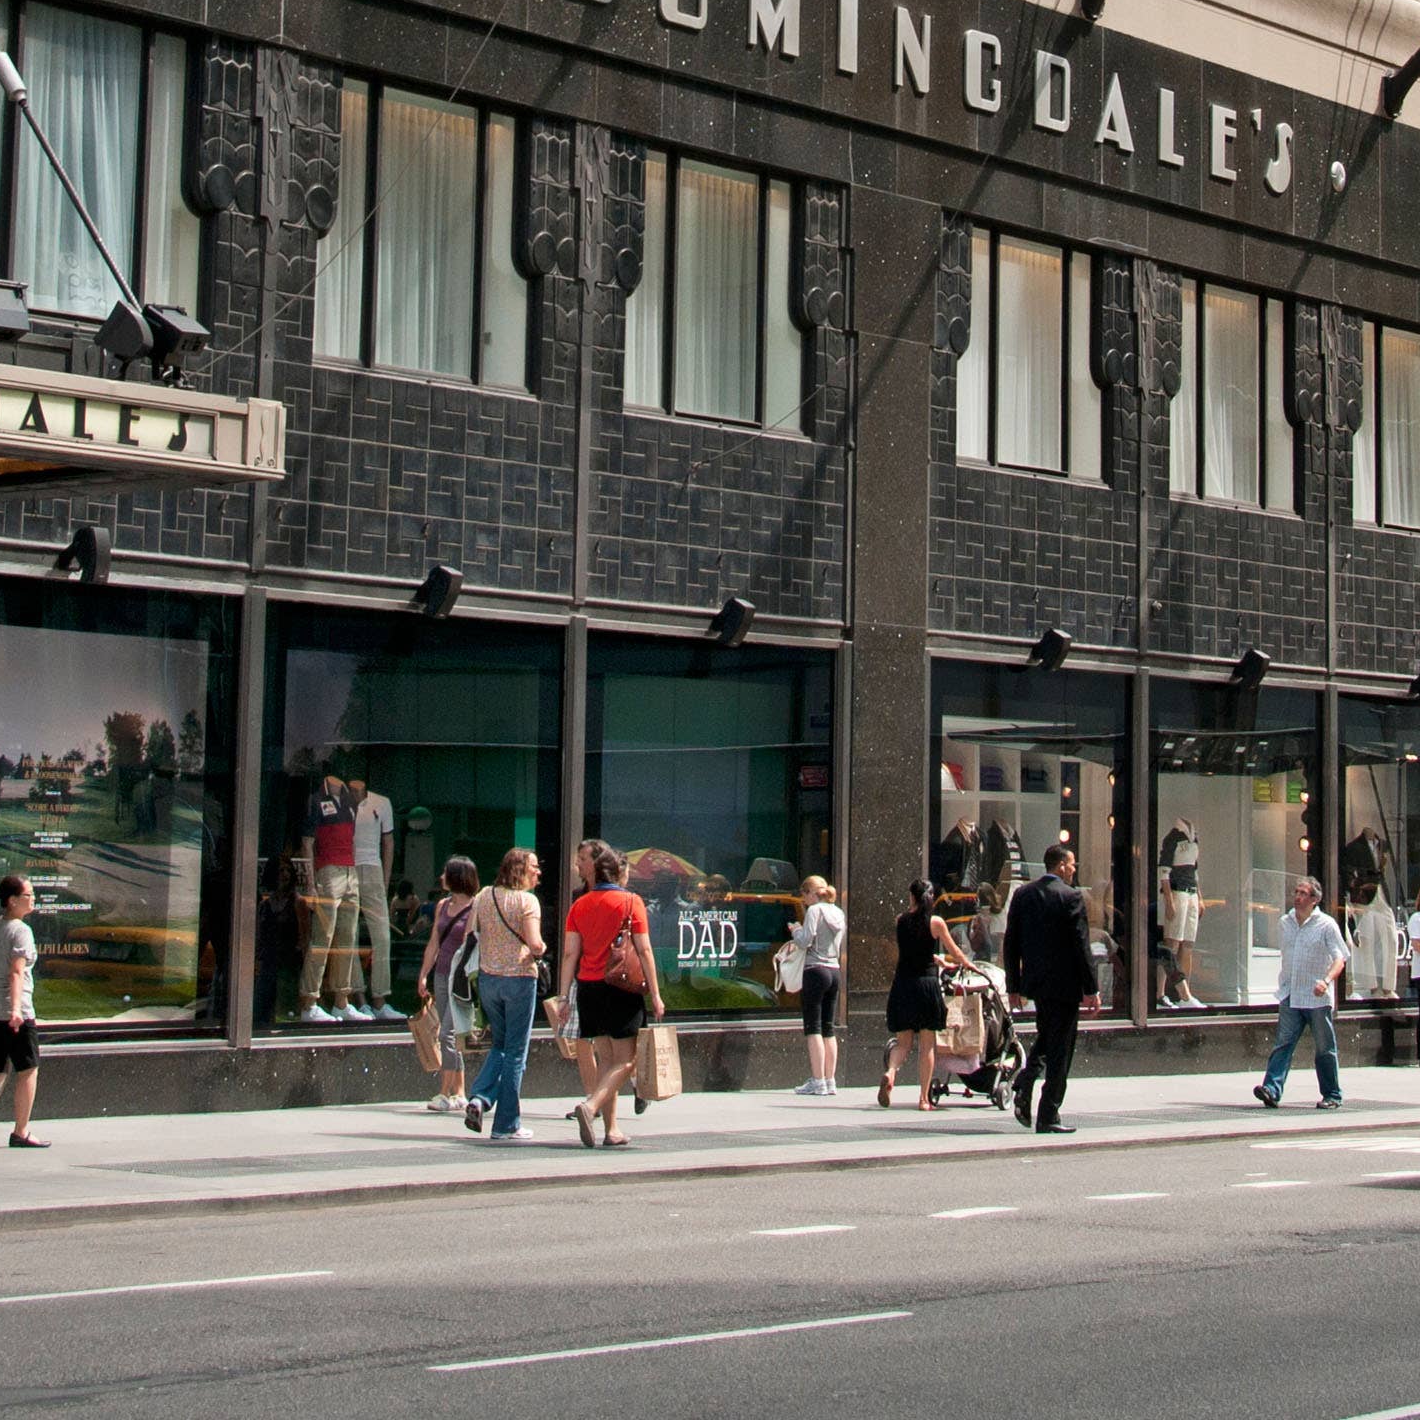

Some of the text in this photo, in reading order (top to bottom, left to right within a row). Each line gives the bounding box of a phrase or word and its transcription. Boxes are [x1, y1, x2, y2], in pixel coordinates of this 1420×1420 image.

[678, 910, 738, 922] ALL-AMERICAN
[677, 920, 738, 959] DAD
[57, 942, 90, 955] LAUREN
